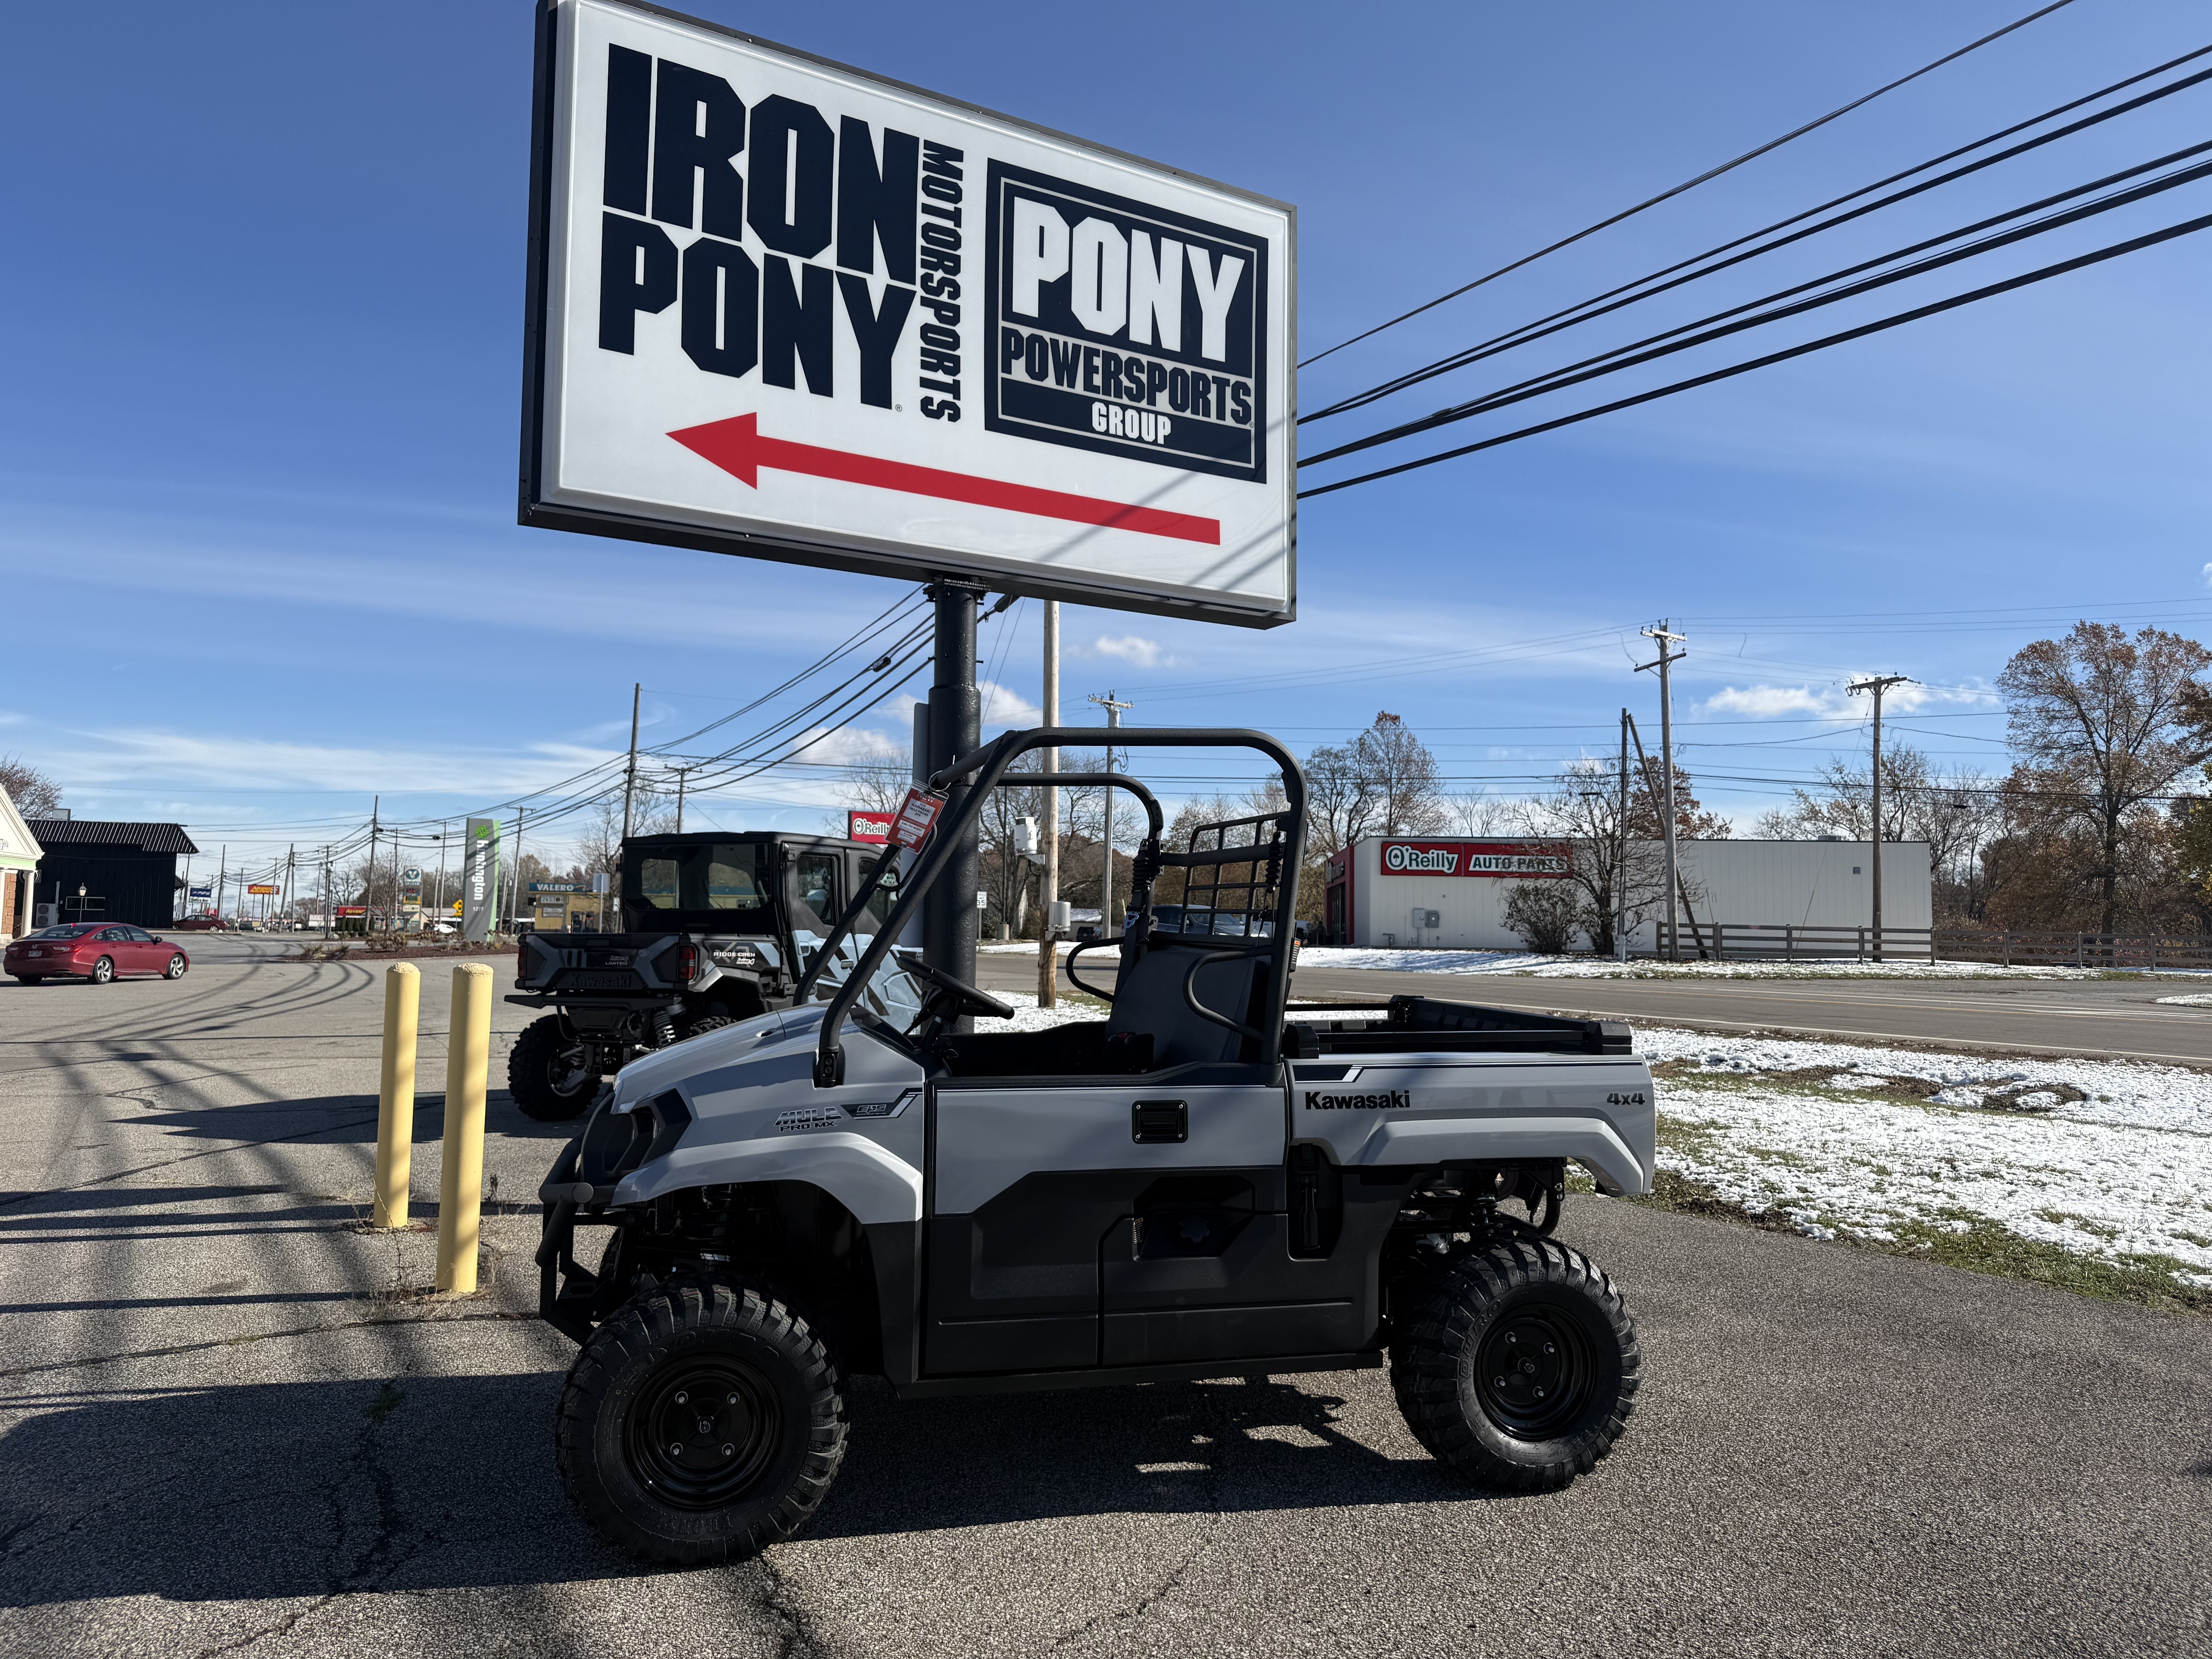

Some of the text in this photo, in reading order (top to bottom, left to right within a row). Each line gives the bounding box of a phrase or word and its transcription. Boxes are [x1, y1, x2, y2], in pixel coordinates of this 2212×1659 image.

[603, 43, 920, 286] IRON
[920, 139, 963, 422] MOTORSPORTS
[1012, 196, 1245, 362] PONY
[599, 211, 917, 410] PONY
[1001, 326, 1252, 425] POWERSPORTS
[1092, 402, 1171, 445] GROUP
[912, 803, 931, 813] KAWASAKI
[917, 792, 935, 802] NEW
[472, 840, 489, 900] huntington
[1388, 847, 1456, 870] O'Reilly
[1473, 857, 1565, 869] AUTO PARTS
[570, 973, 632, 988] Kawasaki
[1305, 1090, 1410, 1110] Kawasaki
[1607, 1093, 1645, 1105] 4x4
[774, 1106, 843, 1126] MULE
[1459, 1299, 1502, 1379] DURO
